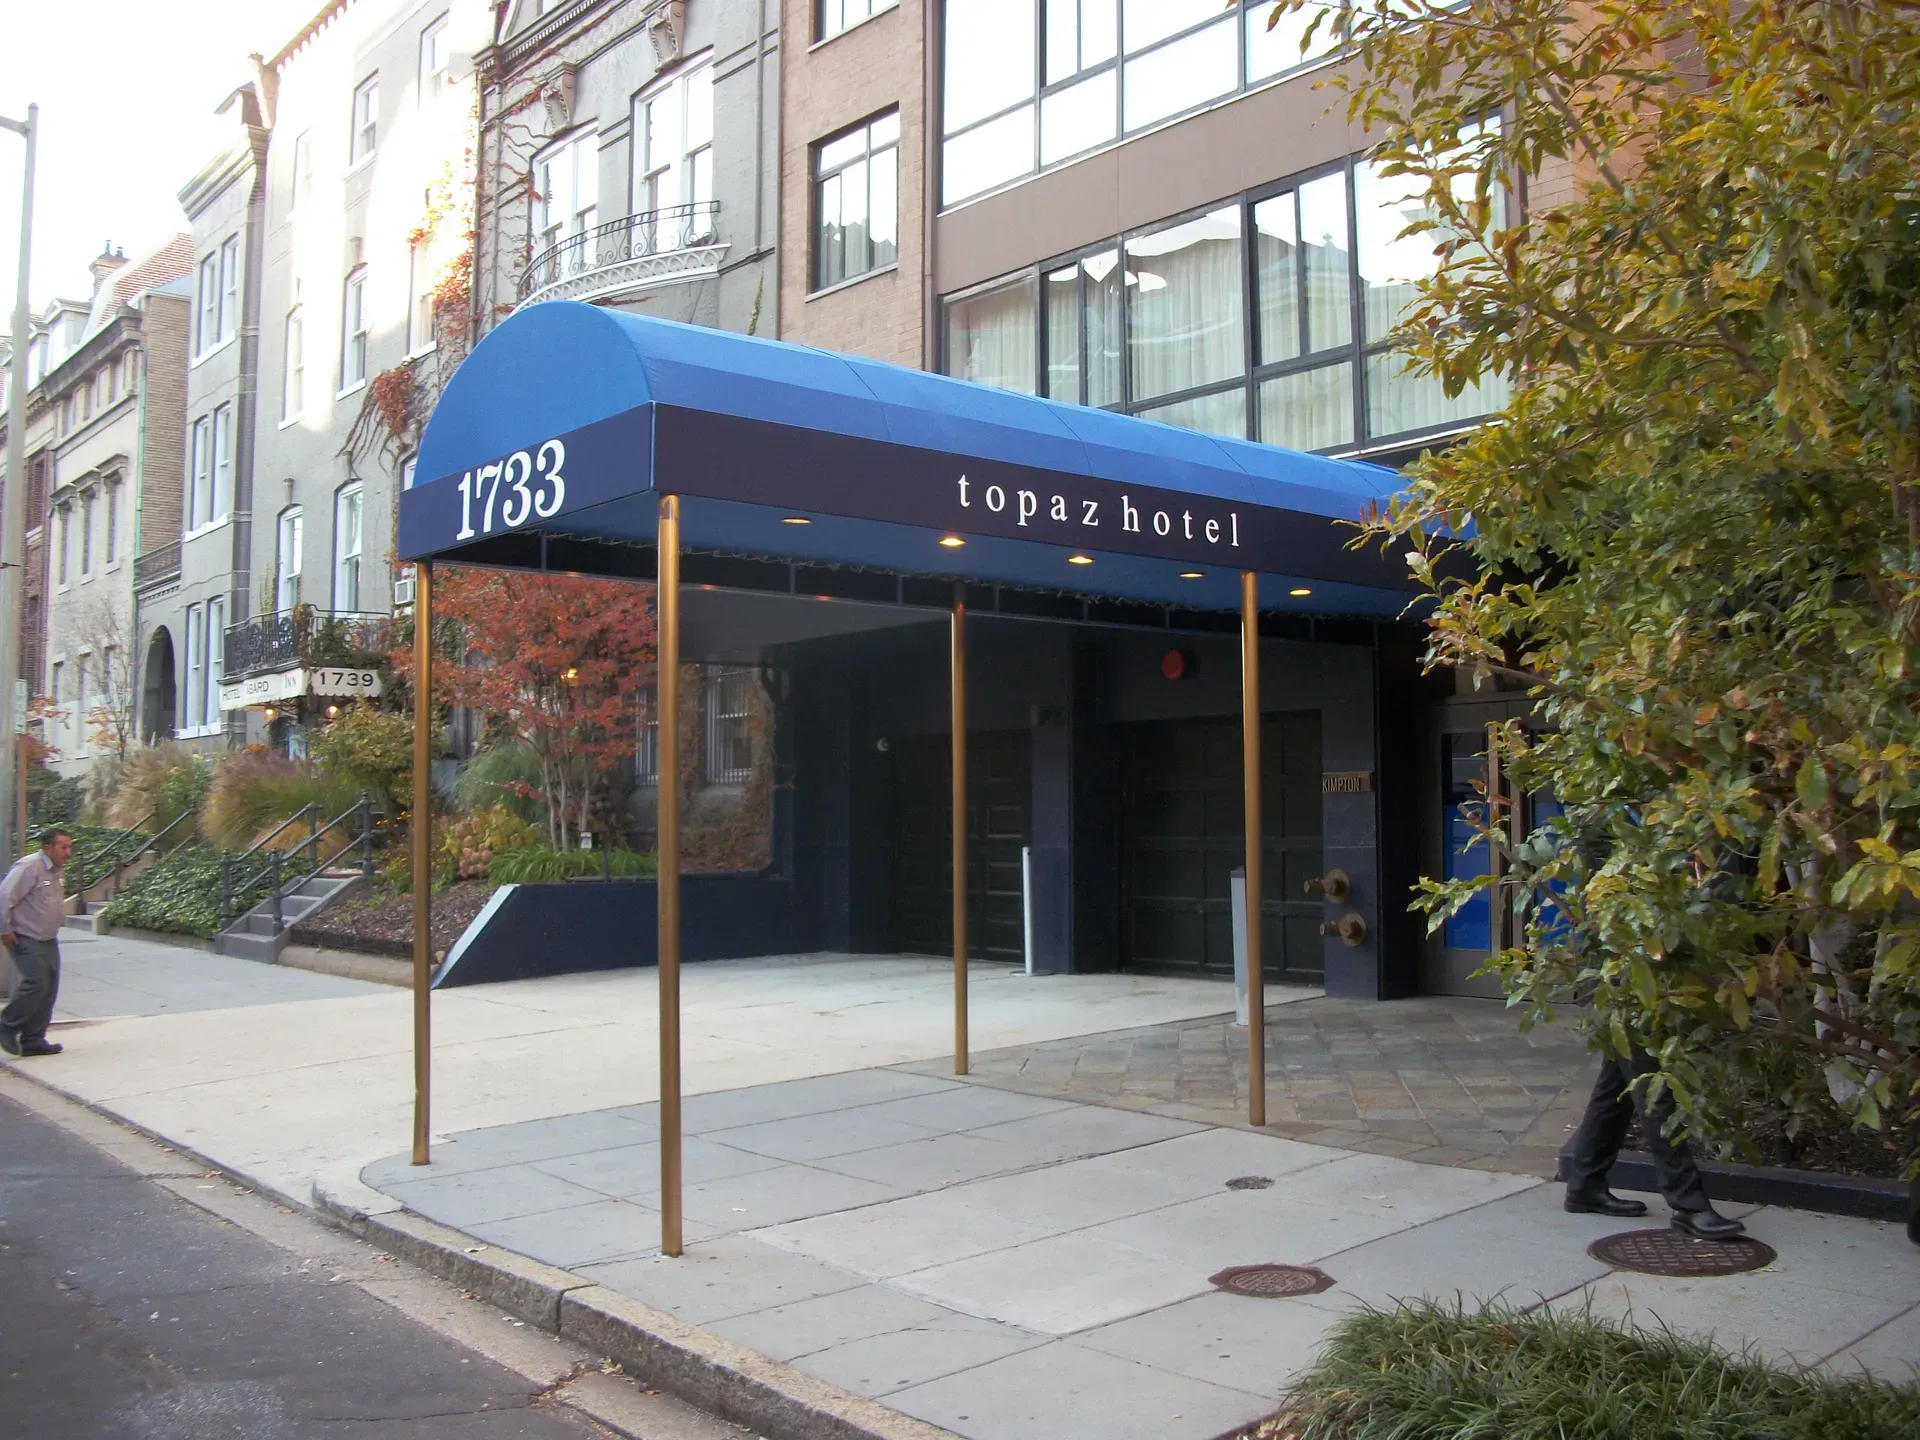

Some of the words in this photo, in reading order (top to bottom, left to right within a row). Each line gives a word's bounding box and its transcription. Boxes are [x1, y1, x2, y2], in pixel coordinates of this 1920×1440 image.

[457, 439, 565, 541] 1733
[957, 474, 1099, 526] topaz
[1121, 495, 1239, 546] hotel
[320, 672, 374, 687] 1739
[1322, 777, 1360, 793] KIMPTON
